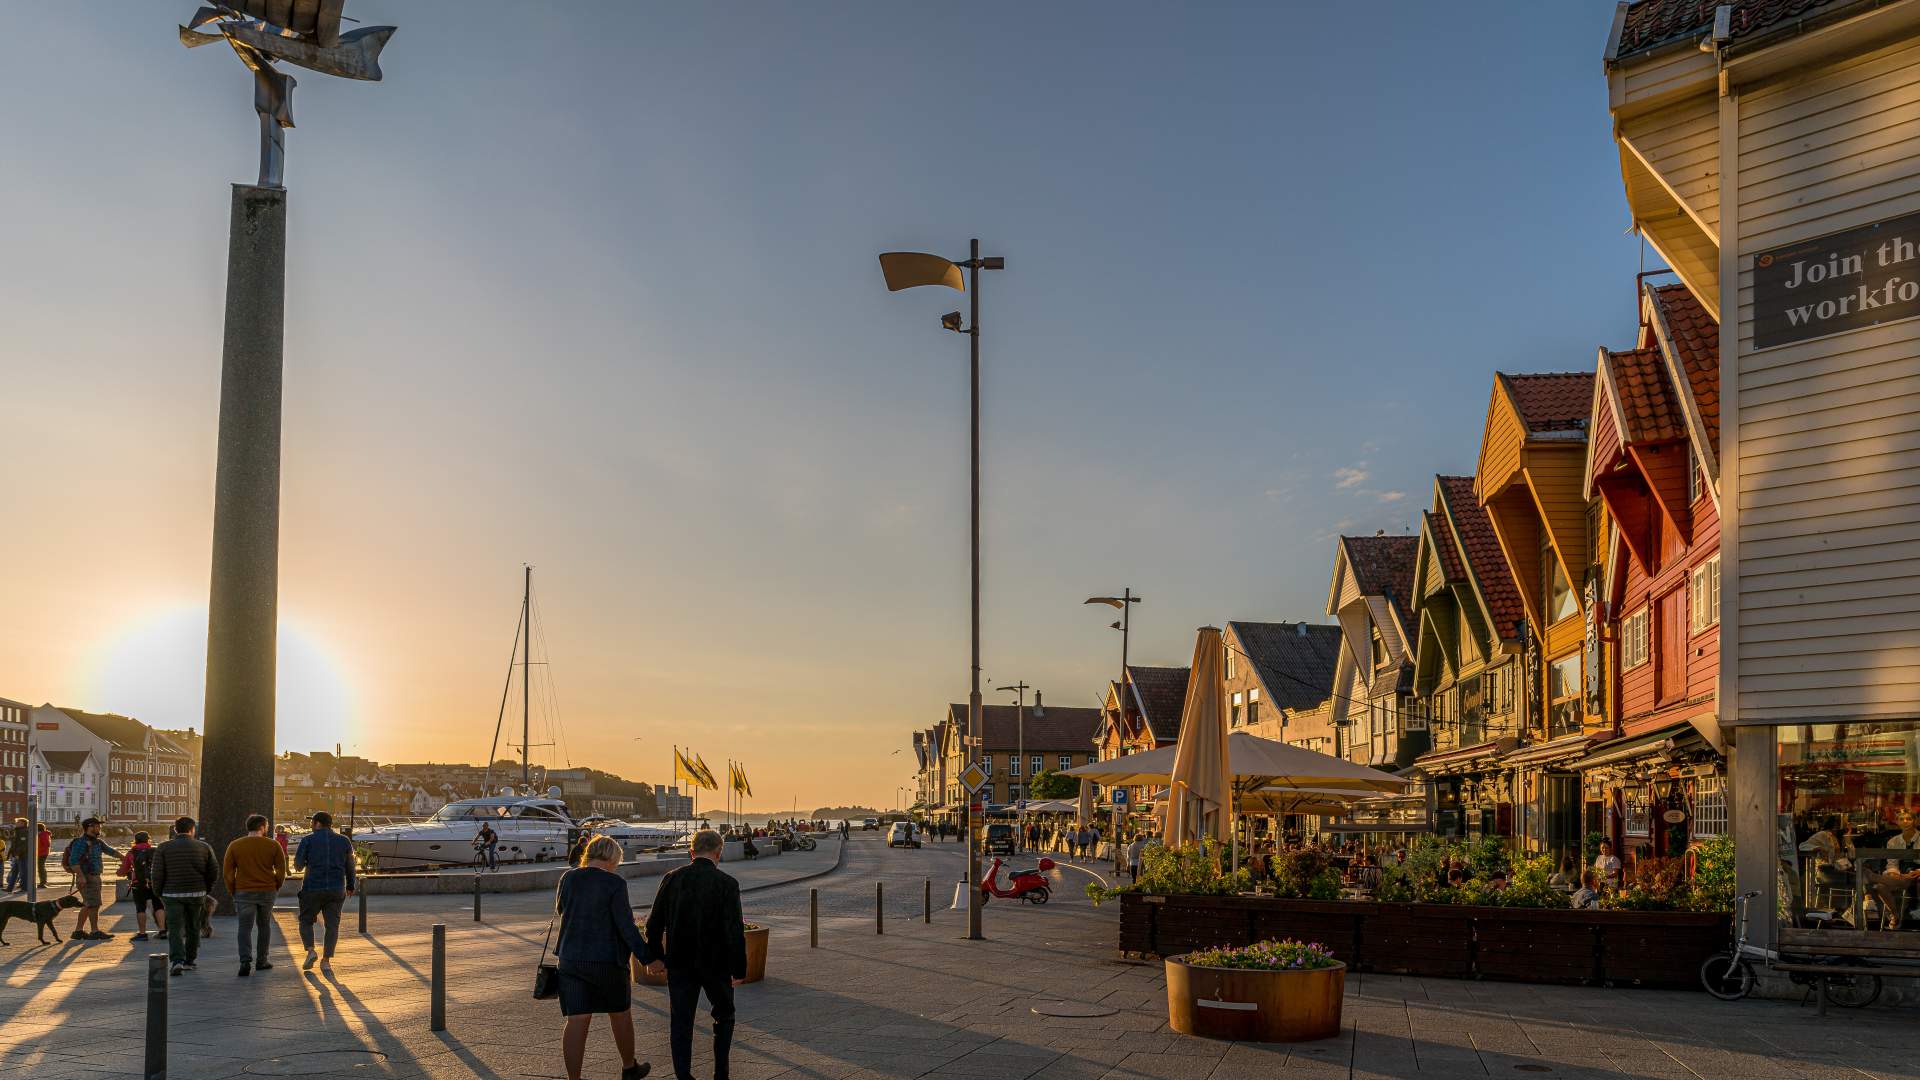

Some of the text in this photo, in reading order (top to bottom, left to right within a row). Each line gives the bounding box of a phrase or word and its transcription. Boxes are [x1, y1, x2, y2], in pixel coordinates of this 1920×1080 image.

[1785, 253, 1863, 289] Join
[1876, 237, 1920, 267] th
[1785, 277, 1920, 327] workfo
